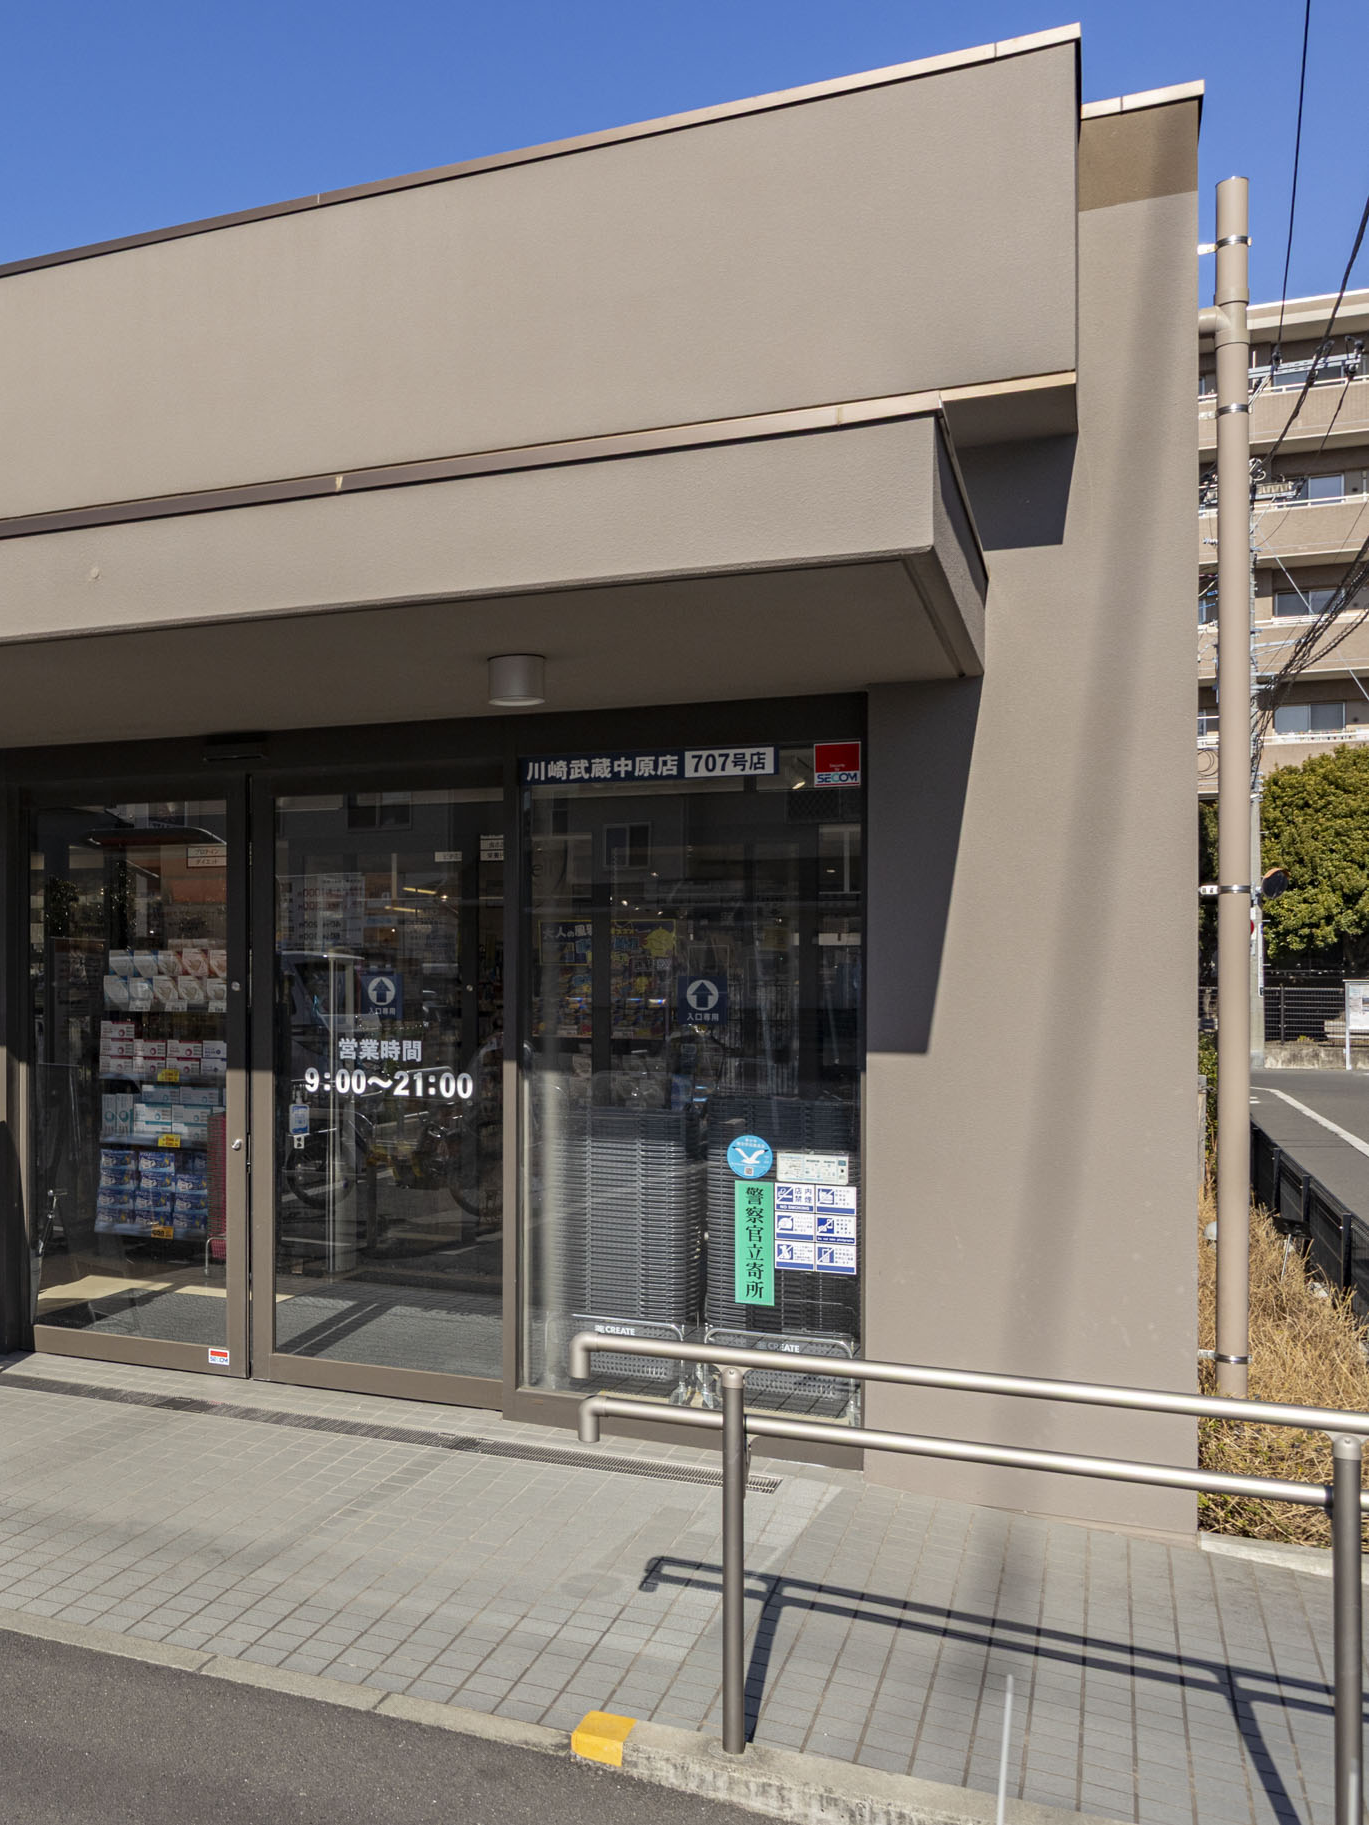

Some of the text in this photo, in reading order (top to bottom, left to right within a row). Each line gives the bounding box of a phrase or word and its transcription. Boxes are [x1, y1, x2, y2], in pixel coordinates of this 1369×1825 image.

[526, 751, 766, 781] 川崎武蔵中原店 707号店
[817, 772, 858, 783] SECOM
[686, 1012, 719, 1022] 入口専用
[338, 1038, 422, 1062] 営業時間
[745, 1186, 764, 1299] 警察官立寄所
[605, 1325, 635, 1336] CREATE
